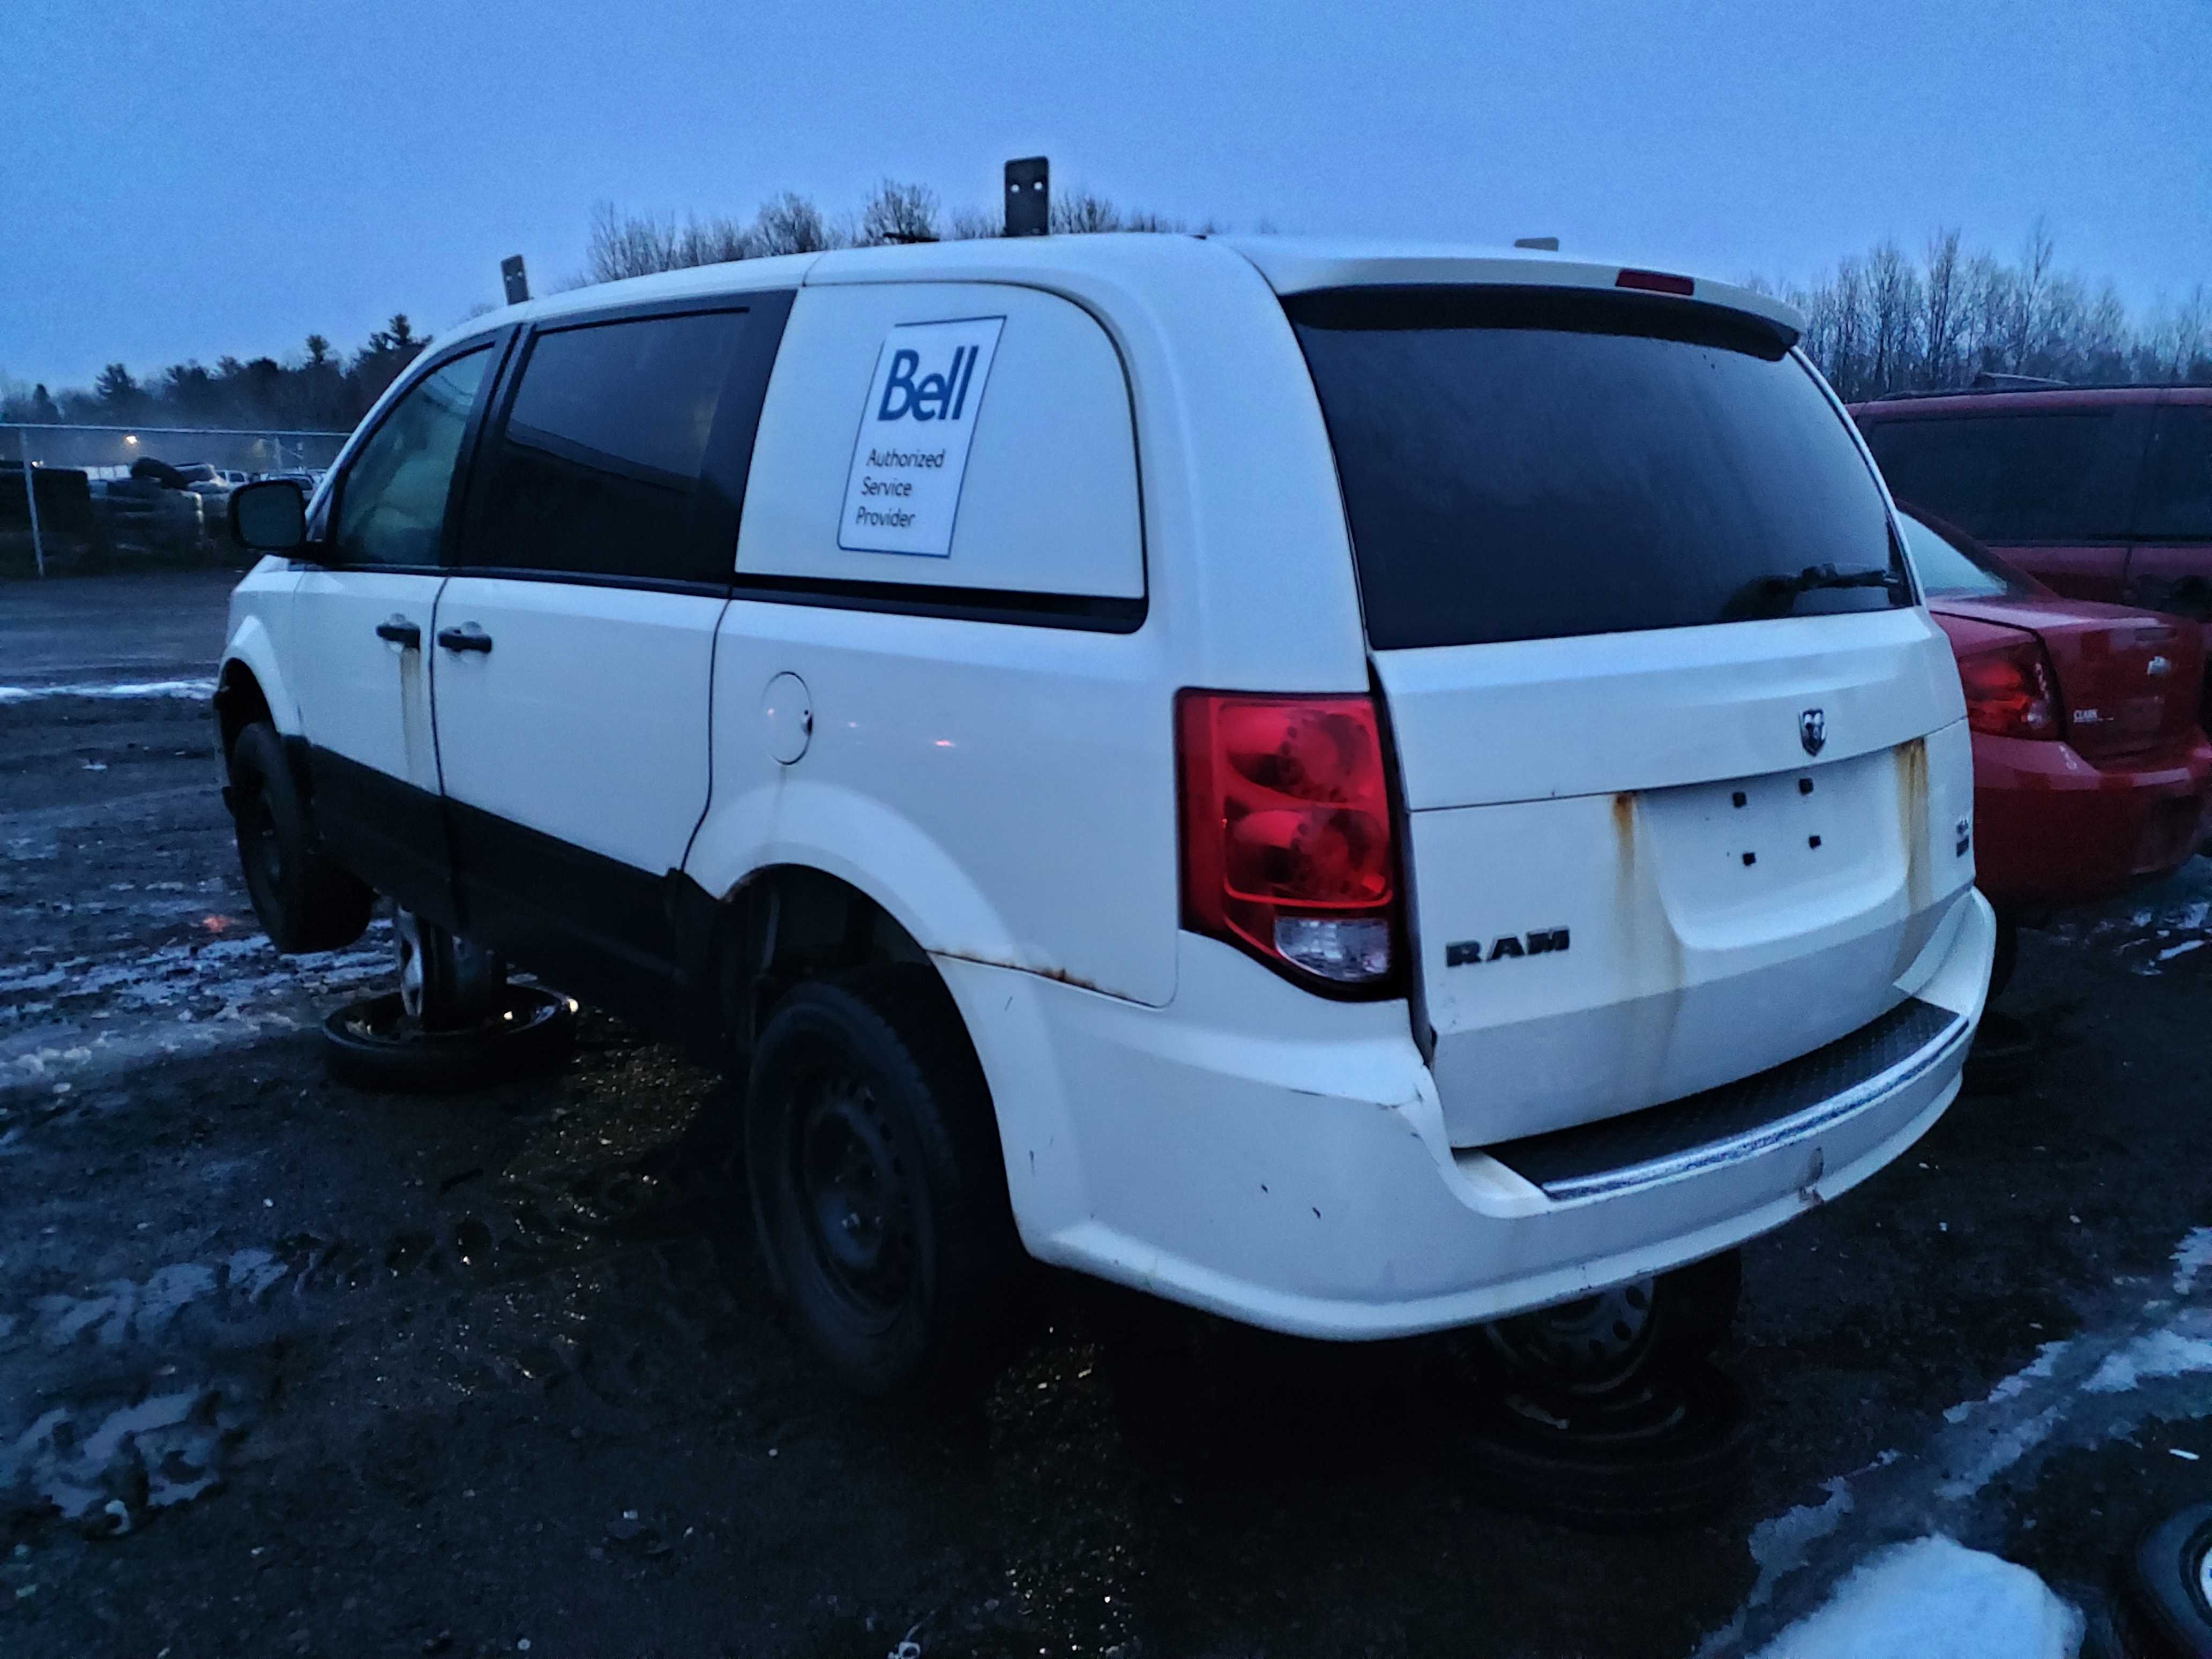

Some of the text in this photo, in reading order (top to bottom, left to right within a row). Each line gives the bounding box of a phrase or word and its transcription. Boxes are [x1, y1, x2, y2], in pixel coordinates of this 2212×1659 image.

[877, 345, 980, 422] Bell
[866, 448, 946, 468] Authorized
[861, 476, 913, 496] Service
[856, 505, 916, 527] Provider
[1446, 925, 1570, 967] RAM
